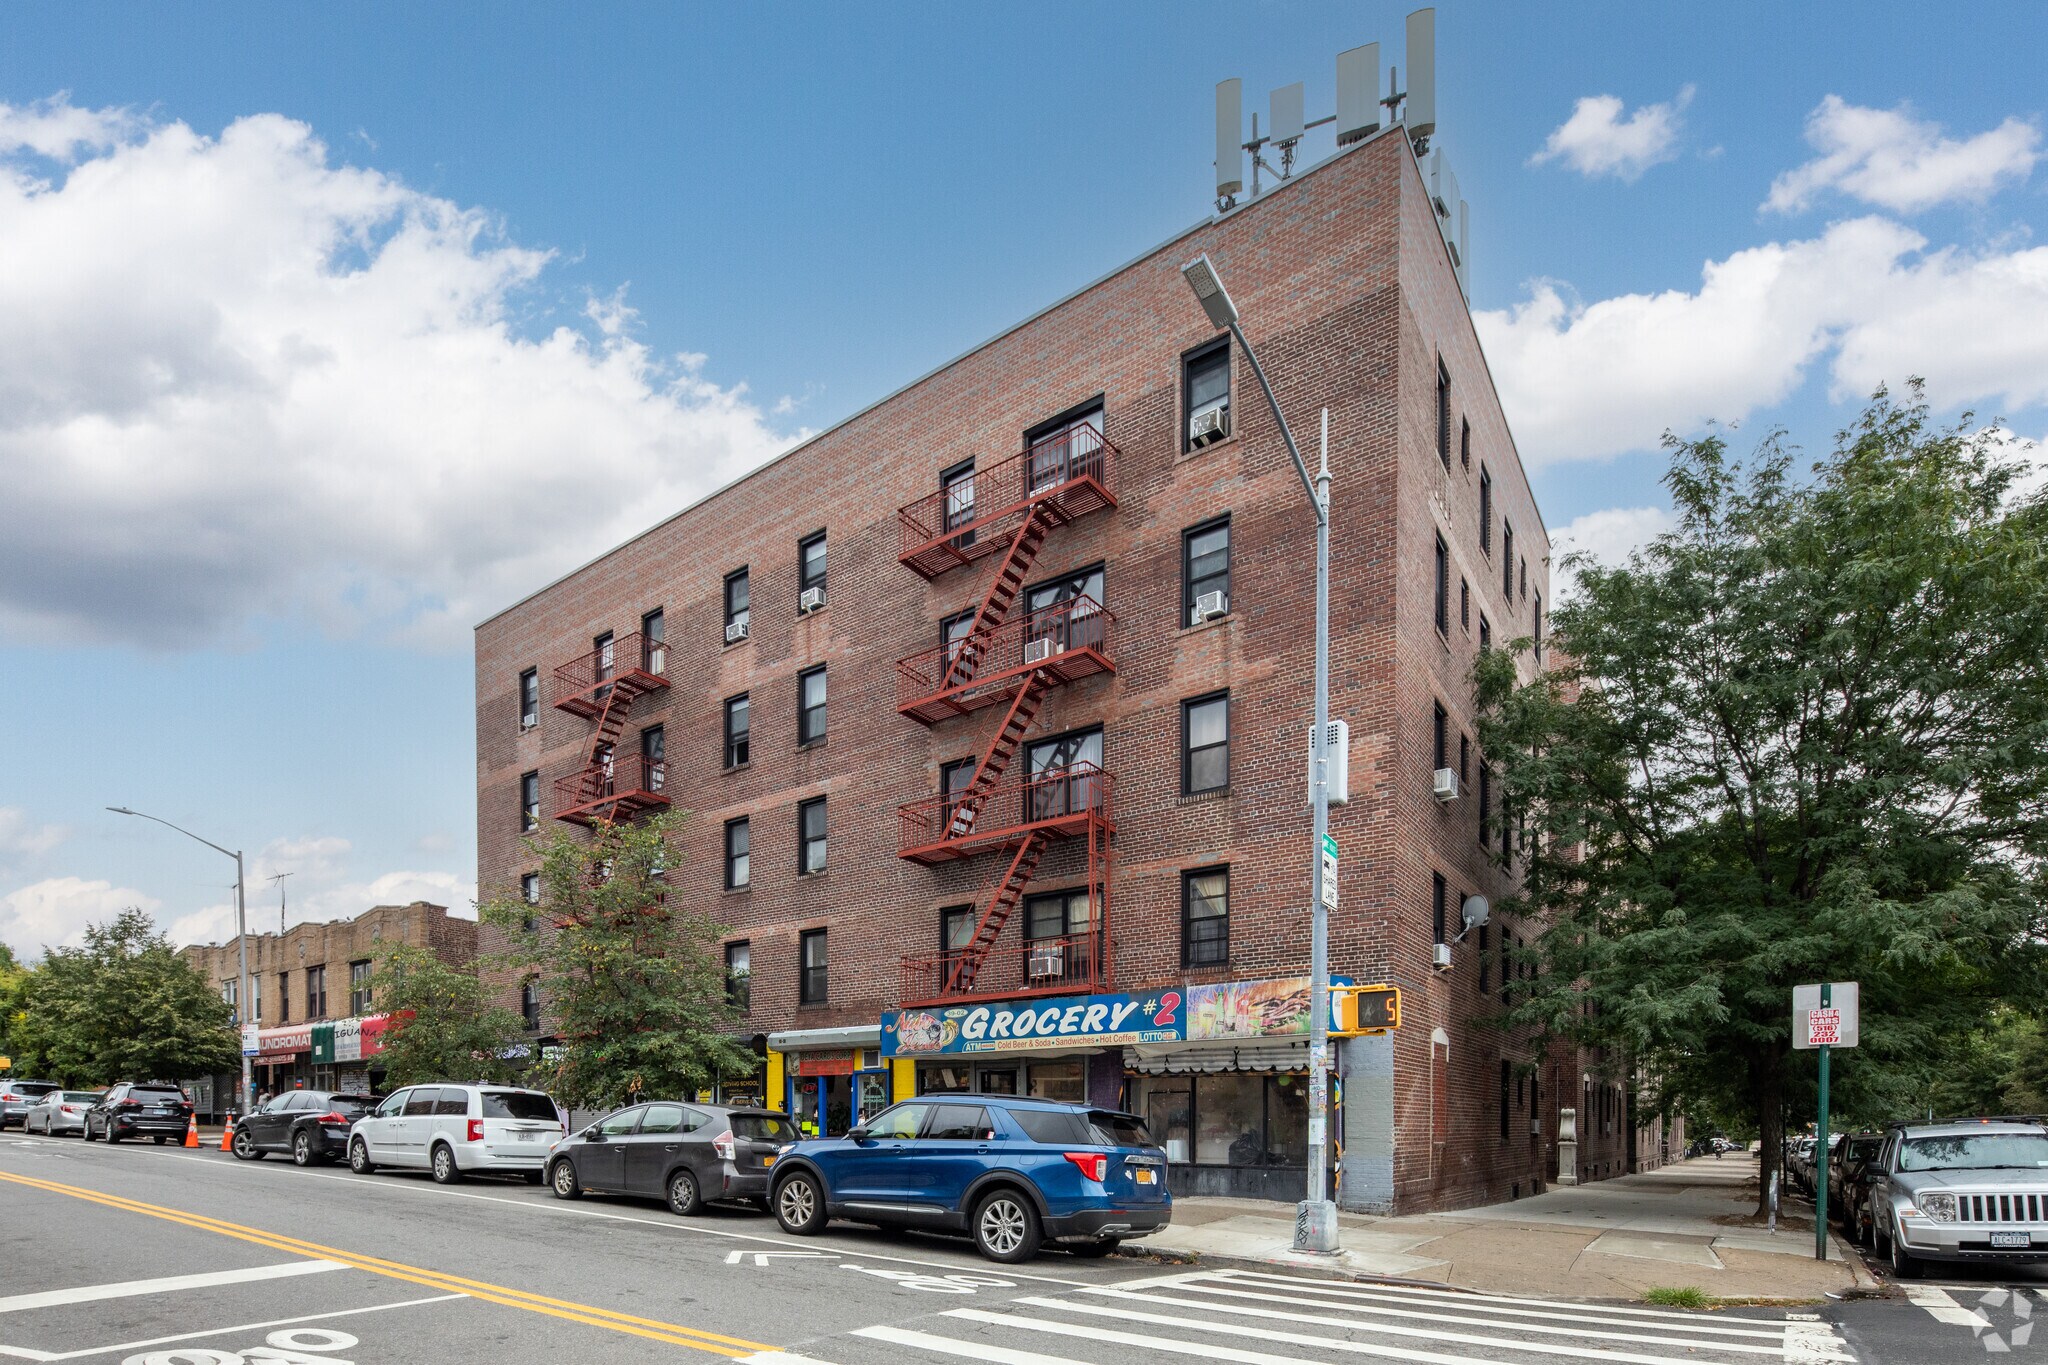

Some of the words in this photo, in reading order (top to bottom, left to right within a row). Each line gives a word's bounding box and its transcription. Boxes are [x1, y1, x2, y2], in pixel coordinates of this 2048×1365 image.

[947, 1009, 965, 1017] 39-02
[1386, 997, 1396, 1022] 5
[961, 1001, 1139, 1040] GROCERY
[1810, 1017, 1839, 1025] CARS
[997, 1041, 1011, 1050] Cold
[1012, 1040, 1027, 1049] Beer
[1028, 1039, 1034, 1047] &
[1035, 1039, 1051, 1047] Soda
[1055, 1036, 1095, 1046] Sandwiches
[1100, 1035, 1114, 1043] Hot
[1114, 1033, 1137, 1043] Coffee
[1139, 1031, 1162, 1042] LOTTO
[965, 1042, 982, 1052] ATM
